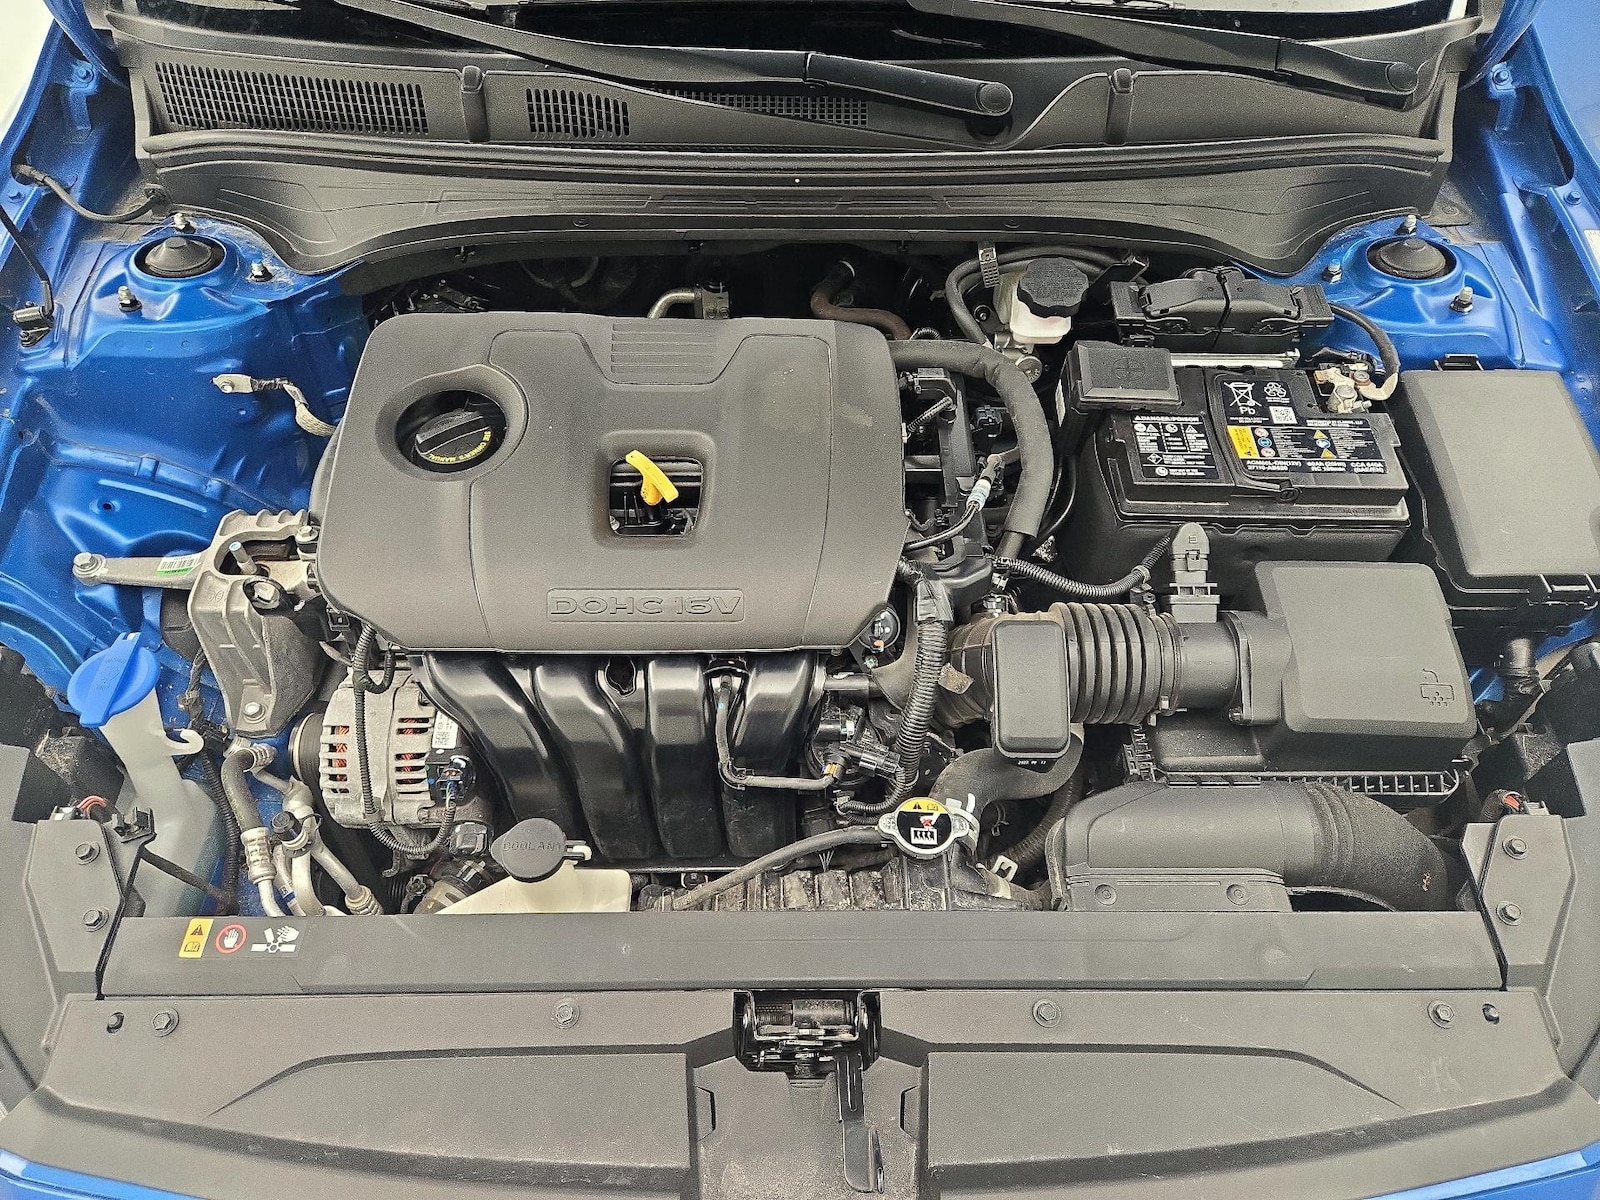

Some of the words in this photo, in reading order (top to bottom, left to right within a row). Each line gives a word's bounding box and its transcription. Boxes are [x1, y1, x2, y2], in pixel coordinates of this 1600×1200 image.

[1239, 406, 1256, 415] Pb
[428, 453, 457, 463] MANUAL
[458, 442, 487, 461] OWNER'S
[550, 597, 664, 615] DOHC
[674, 596, 742, 615] 16V
